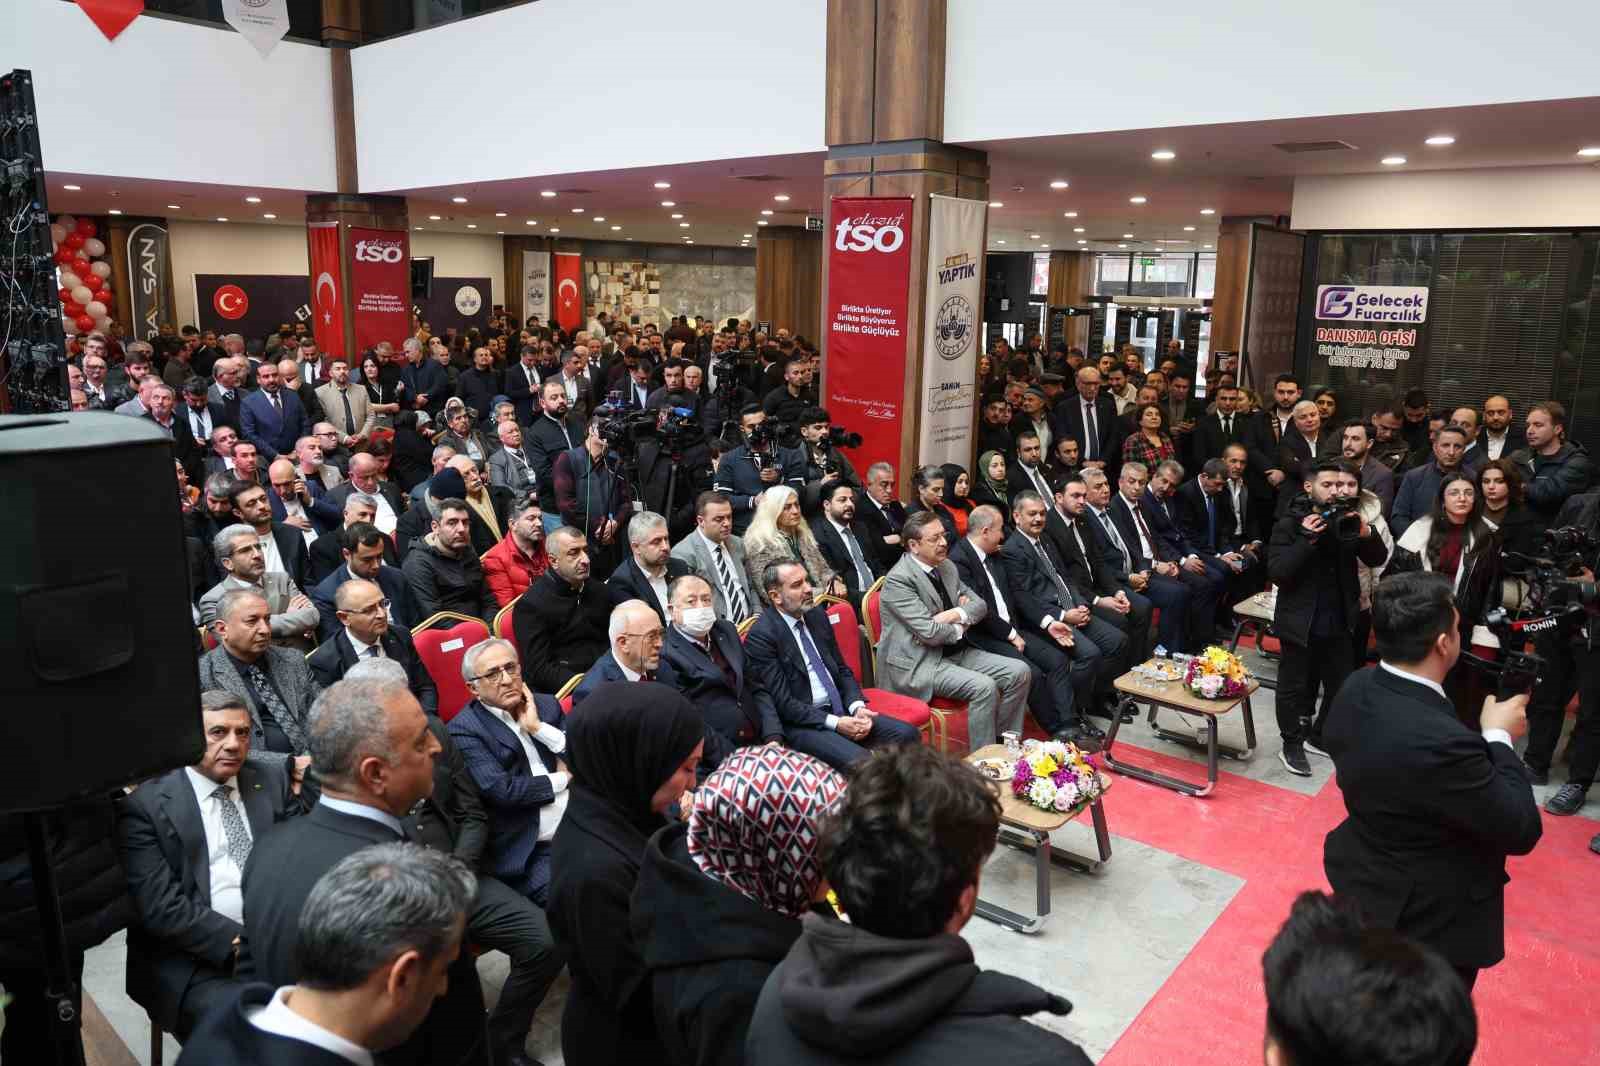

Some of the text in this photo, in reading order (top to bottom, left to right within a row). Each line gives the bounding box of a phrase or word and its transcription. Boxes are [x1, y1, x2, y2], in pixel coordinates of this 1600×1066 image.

[835, 217, 904, 253] tso
[355, 240, 403, 263] tso
[140, 238, 157, 295] SAN
[938, 263, 976, 285] YAPTIK
[1356, 293, 1423, 307] Gelecek
[841, 304, 892, 316] Birlikte Üretiyor
[1355, 308, 1421, 321] Fuarcılık
[837, 313, 896, 326] Birlikte Büyüyoruz
[832, 322, 900, 337] Birlikte Güçlüyüz
[1317, 327, 1417, 347] DANIŞMA OFİSİ
[1522, 617, 1557, 632] RONIN
